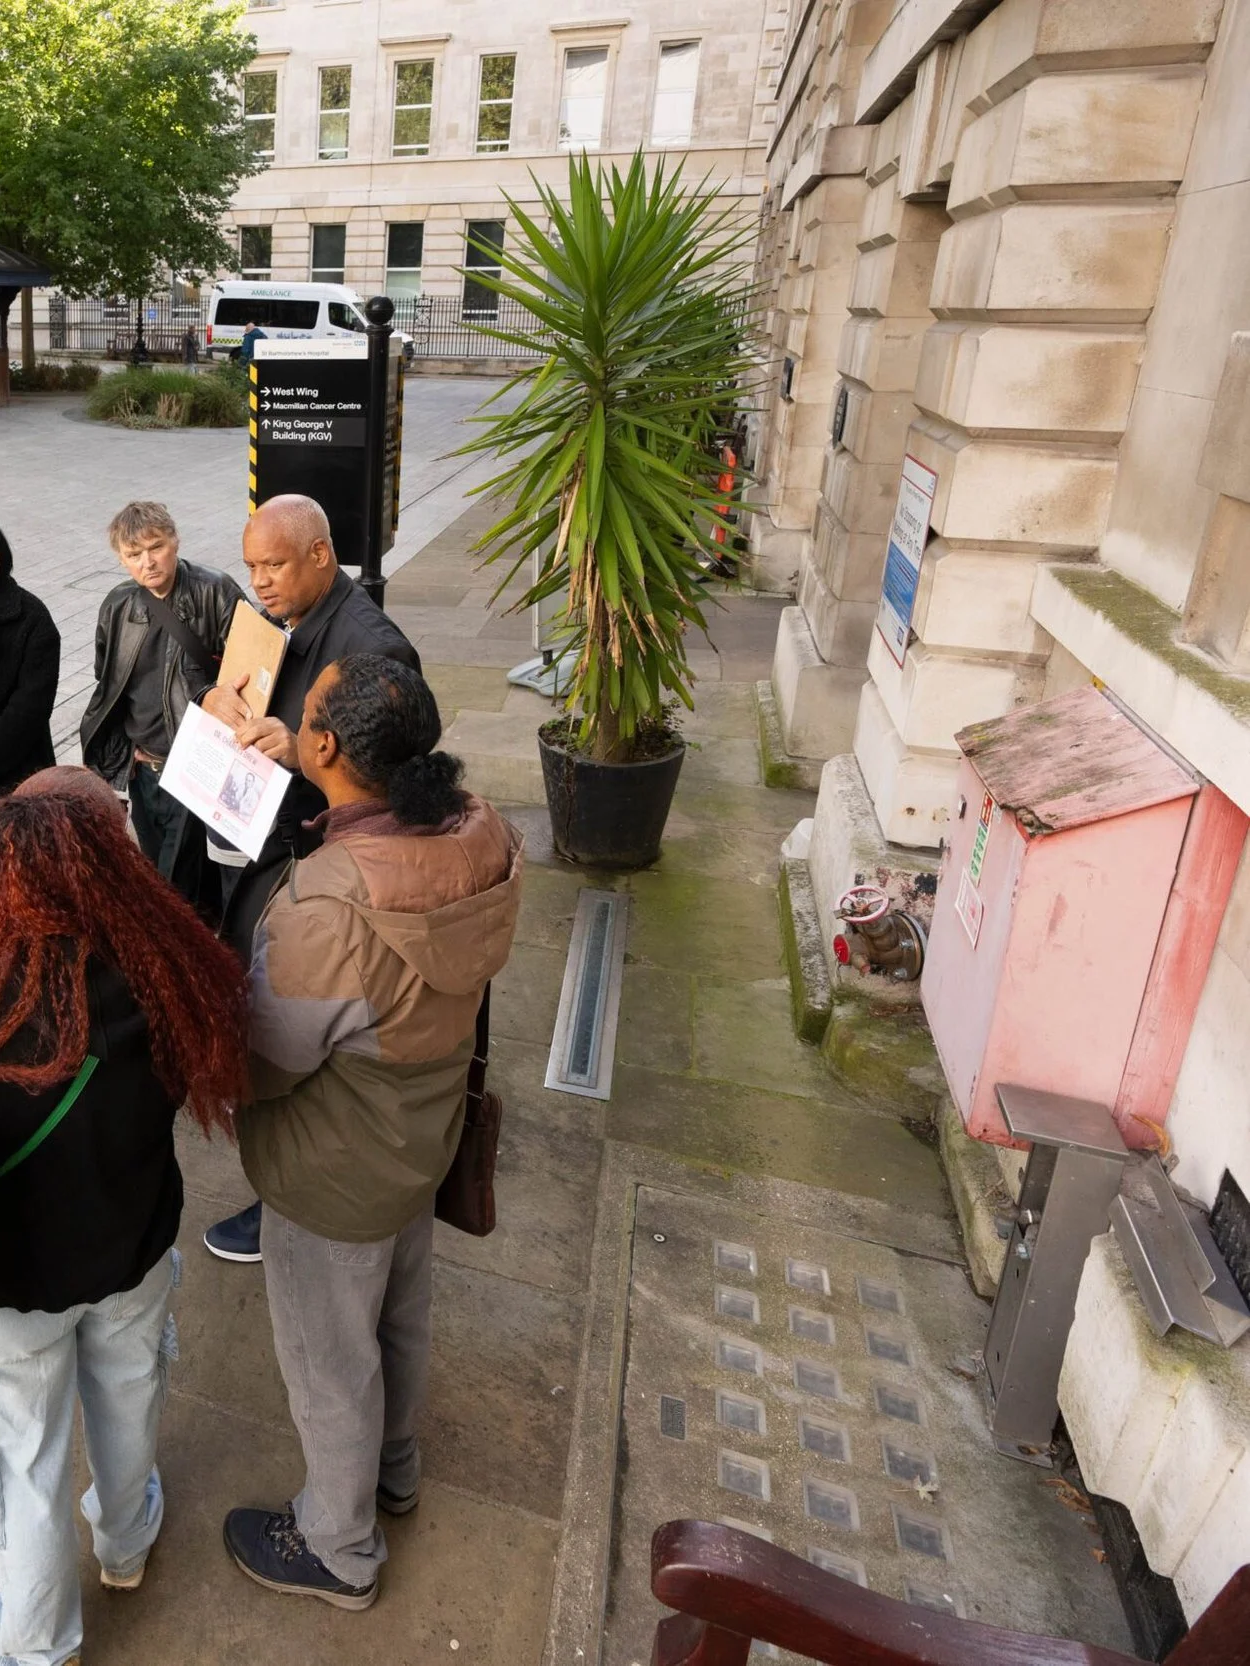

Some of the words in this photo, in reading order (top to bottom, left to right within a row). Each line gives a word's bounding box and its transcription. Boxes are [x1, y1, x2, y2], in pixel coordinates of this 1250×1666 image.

[251, 289, 292, 297] AMBULANCE
[272, 387, 294, 396] West
[296, 387, 319, 398] Wing
[272, 402, 308, 410] Macmillan
[309, 402, 336, 410] Cancer
[336, 402, 362, 410] Centre
[272, 420, 292, 430] King
[293, 420, 325, 430] George
[325, 420, 333, 429] V
[272, 431, 307, 442] Building
[307, 431, 333, 442] (KGV)
